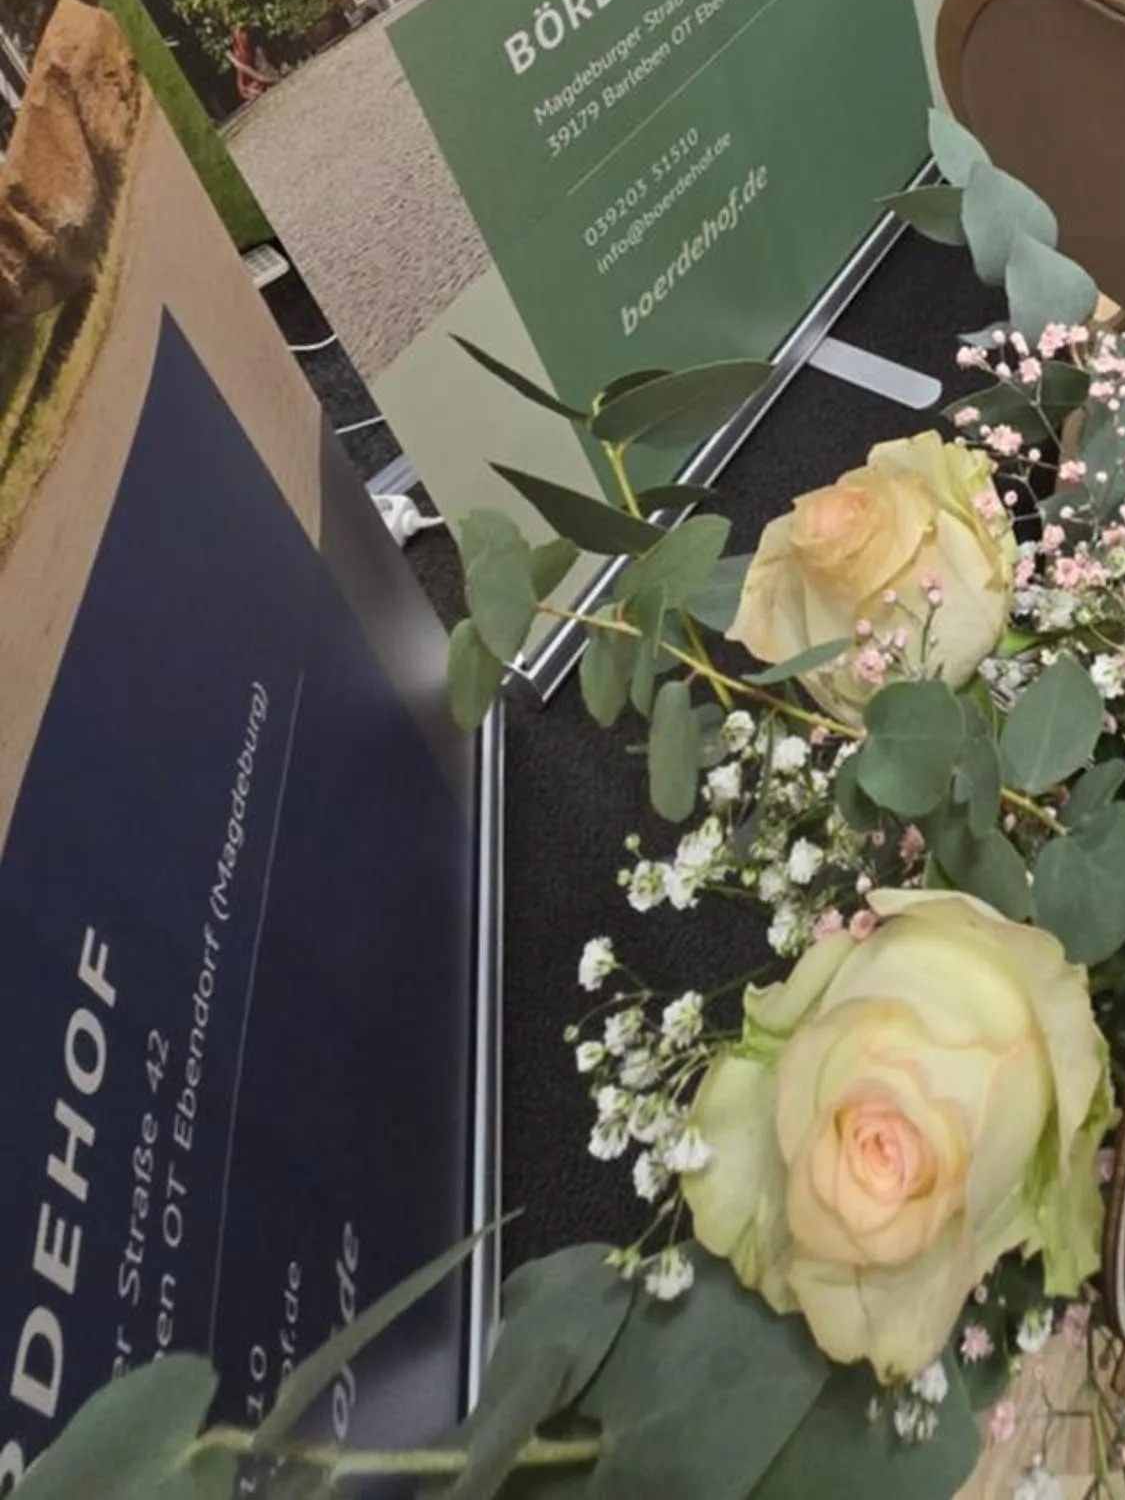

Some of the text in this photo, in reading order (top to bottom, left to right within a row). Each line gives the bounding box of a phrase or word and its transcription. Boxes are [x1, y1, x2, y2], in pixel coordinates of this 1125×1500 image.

[533, 25, 642, 126] Magdeburger
[546, 100, 600, 158] 39179
[600, 42, 671, 109] Barleben
[671, 17, 693, 46] OT
[583, 127, 699, 247] 039203 51510
[596, 131, 731, 275] info@boerdehof.de
[620, 165, 768, 337] boerdehof.de
[210, 680, 269, 921] (Magdeburg)
[173, 921, 221, 1151] Ebendorf
[0, 925, 117, 1500] DEHOF
[118, 1112, 160, 1307] Straße
[145, 1028, 170, 1093] 42
[162, 1162, 188, 1248] OT
